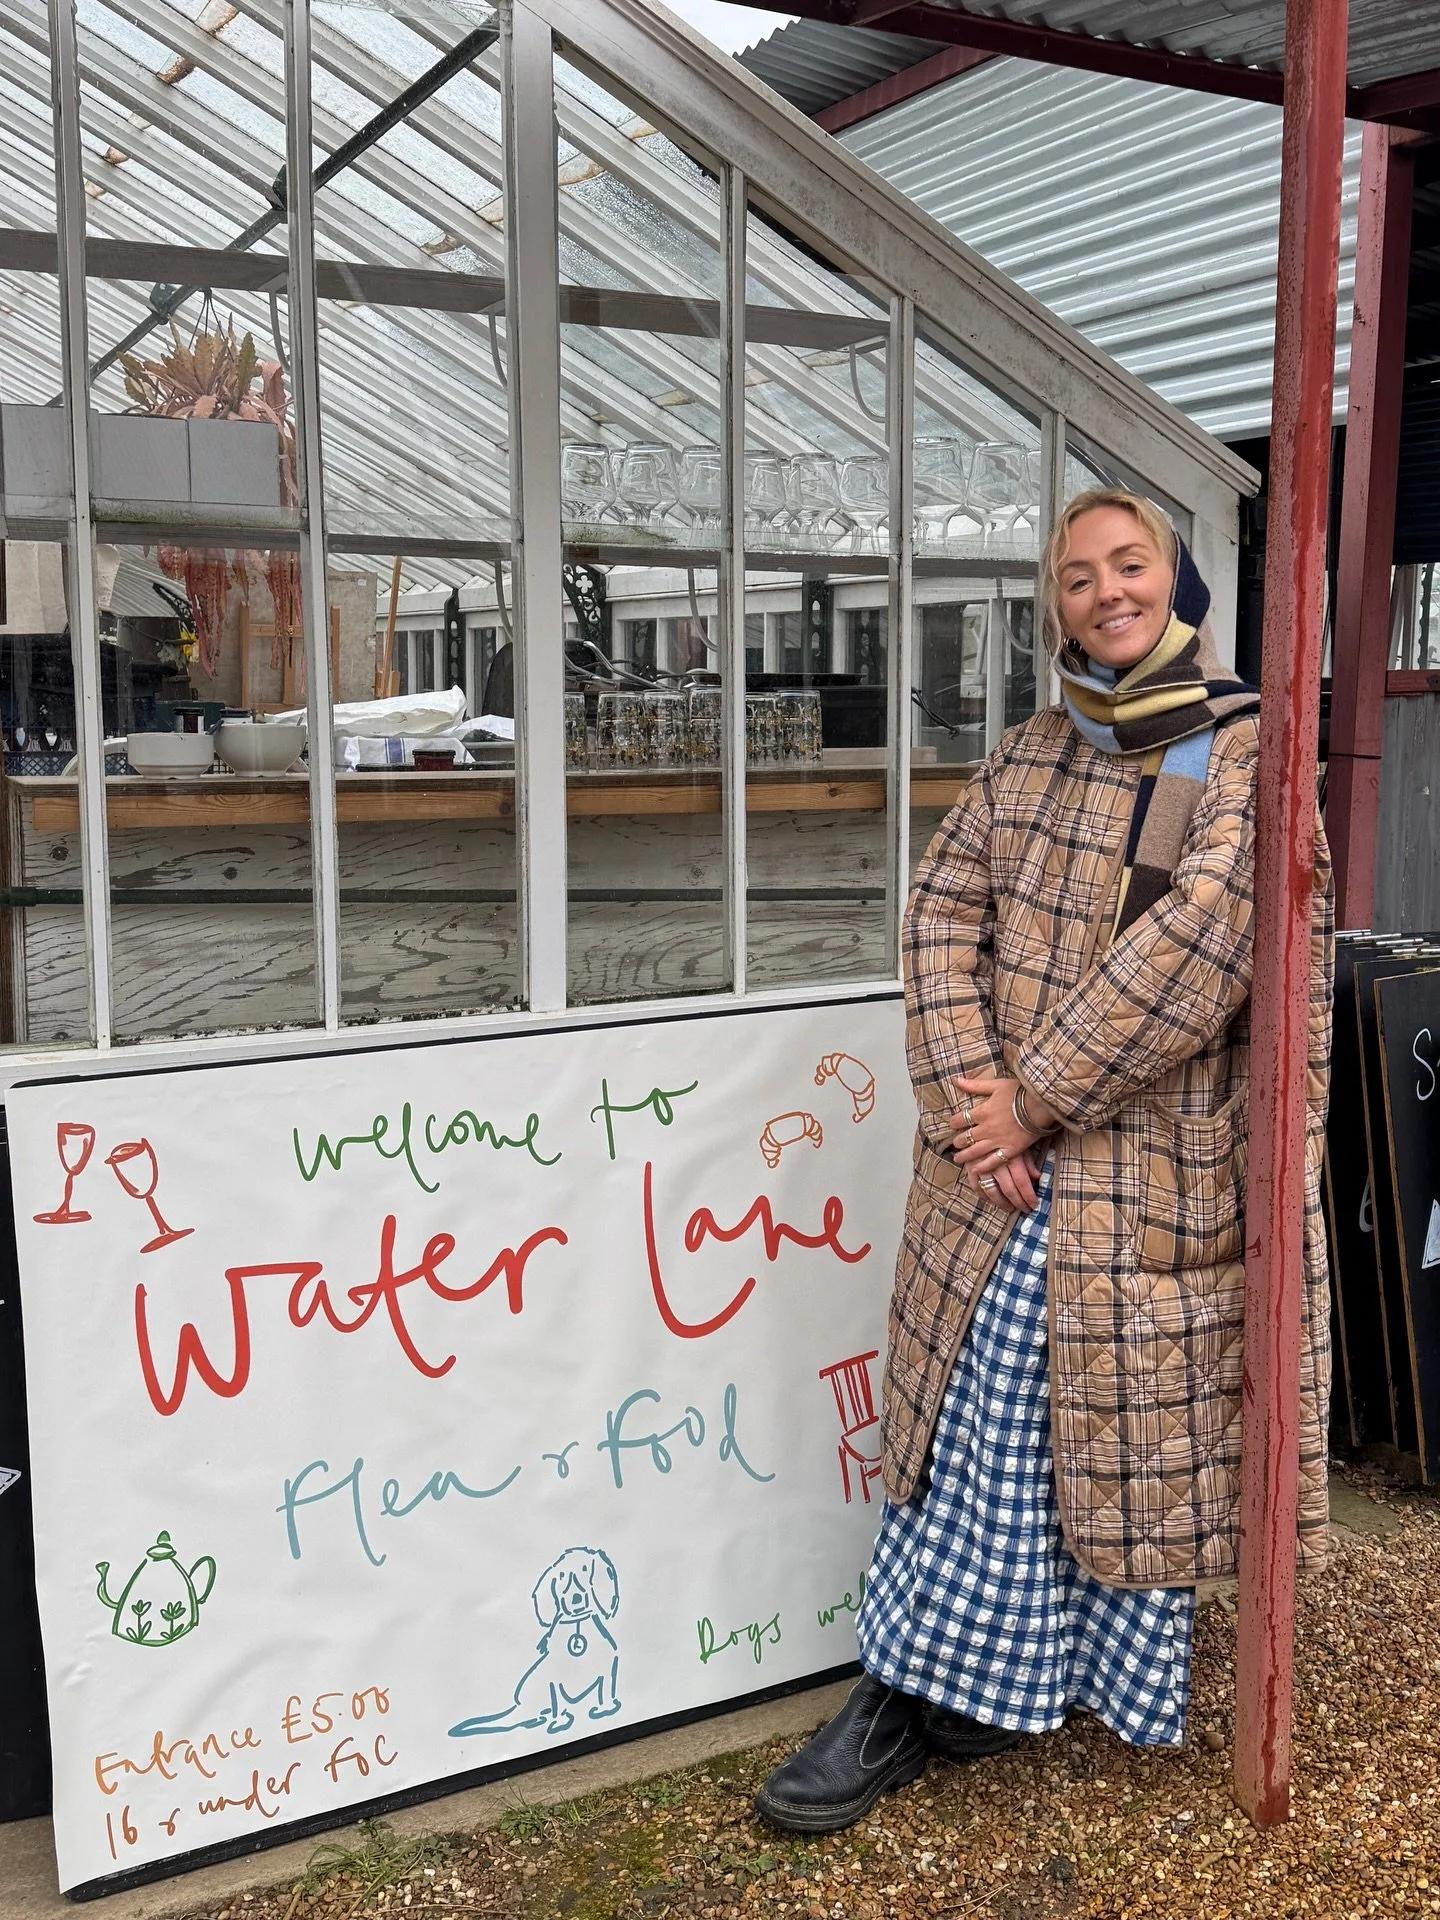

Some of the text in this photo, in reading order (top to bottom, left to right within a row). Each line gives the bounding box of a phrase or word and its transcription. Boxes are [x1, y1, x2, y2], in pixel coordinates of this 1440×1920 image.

[293, 1079, 698, 1192] welcome to
[135, 1161, 872, 1417] Water Lane
[697, 1612, 781, 1664] Dogs
[95, 1730, 262, 1795] Entrance
[106, 1805, 138, 1860] 16
[198, 1761, 301, 1819] under
